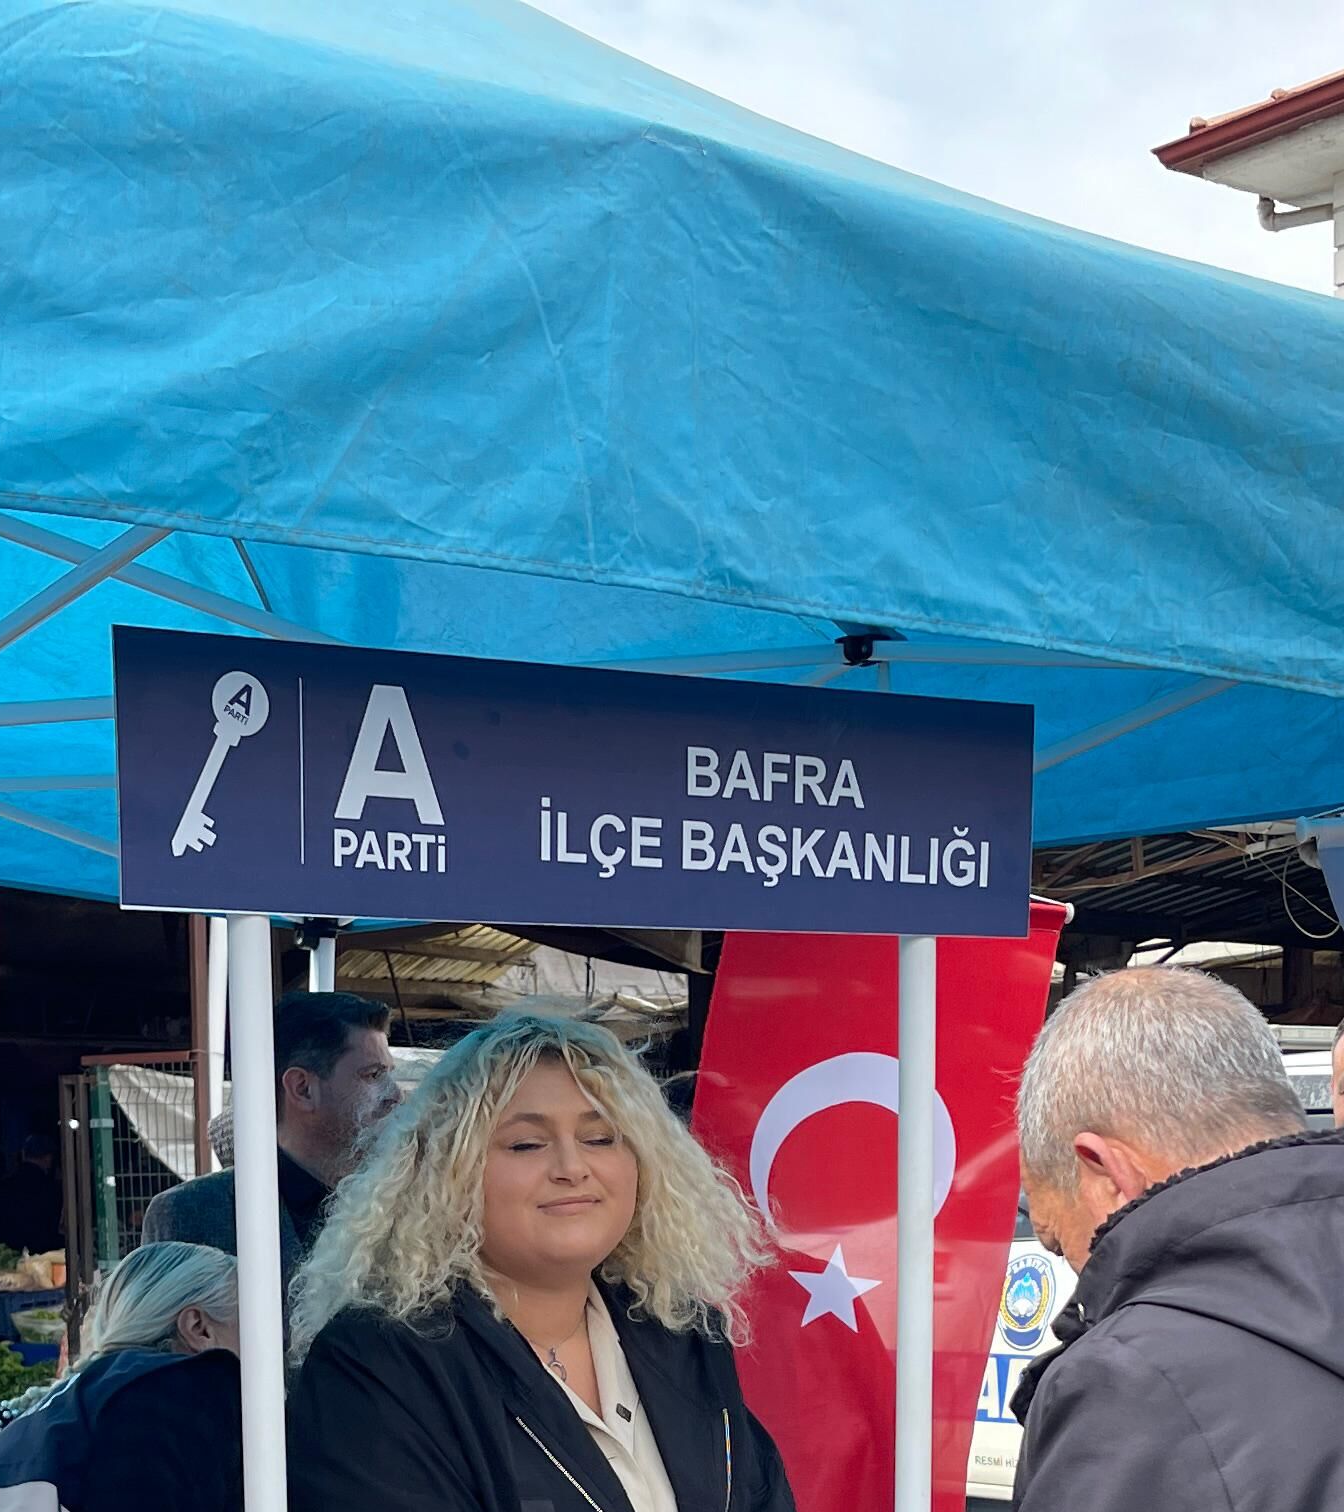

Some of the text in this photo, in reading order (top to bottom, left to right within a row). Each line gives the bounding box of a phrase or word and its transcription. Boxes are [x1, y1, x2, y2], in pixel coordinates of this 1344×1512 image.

[333, 684, 445, 826] A
[686, 746, 865, 811] BAFRA
[539, 796, 991, 888] İLÇE BAŞKANLIĞI
